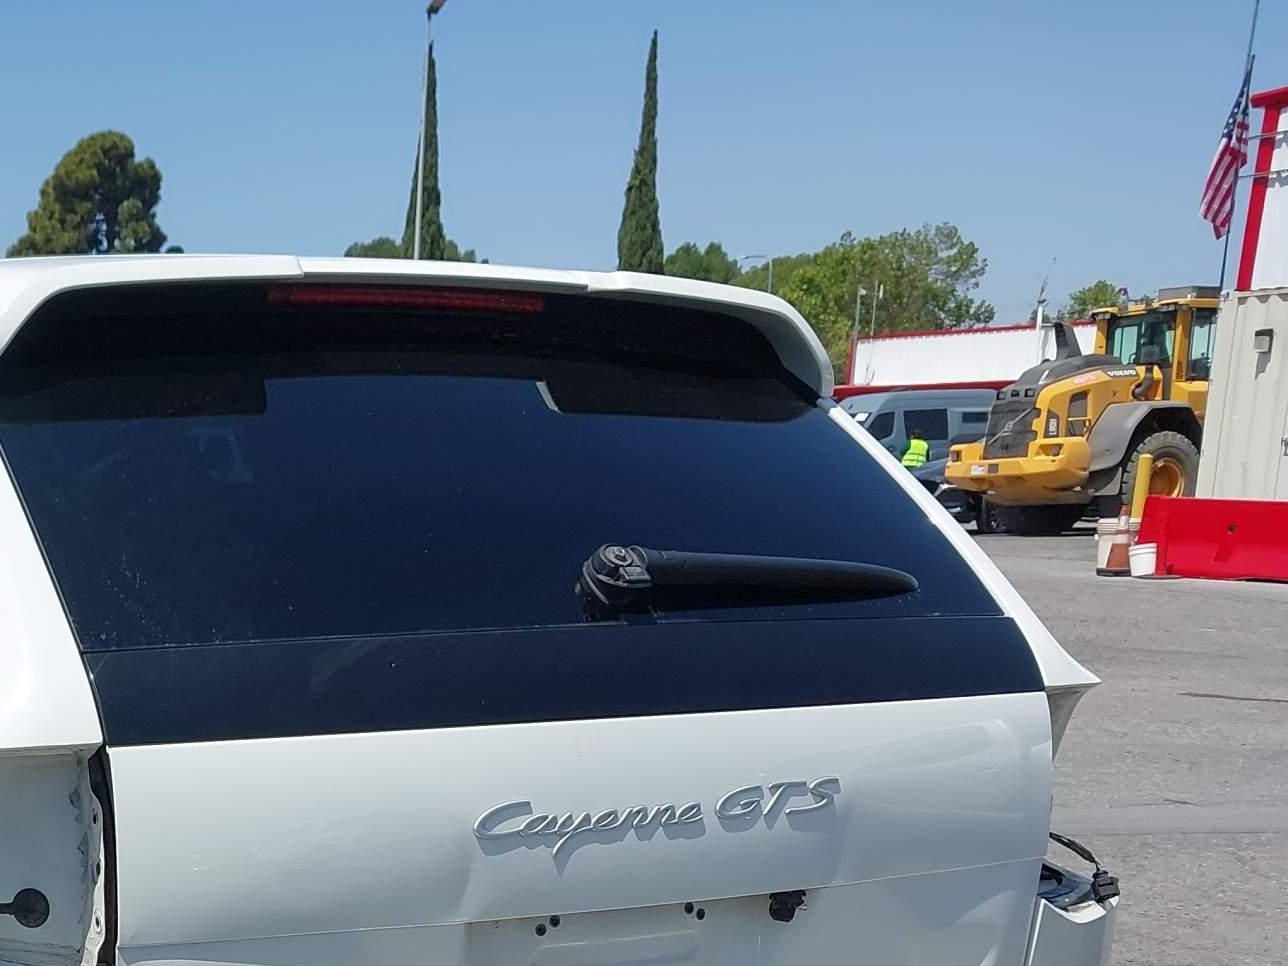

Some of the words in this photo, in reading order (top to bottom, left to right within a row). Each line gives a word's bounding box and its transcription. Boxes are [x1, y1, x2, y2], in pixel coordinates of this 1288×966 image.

[1107, 369, 1137, 377] VOLVO
[473, 799, 705, 858] Cayenne
[715, 775, 841, 819] GTS
